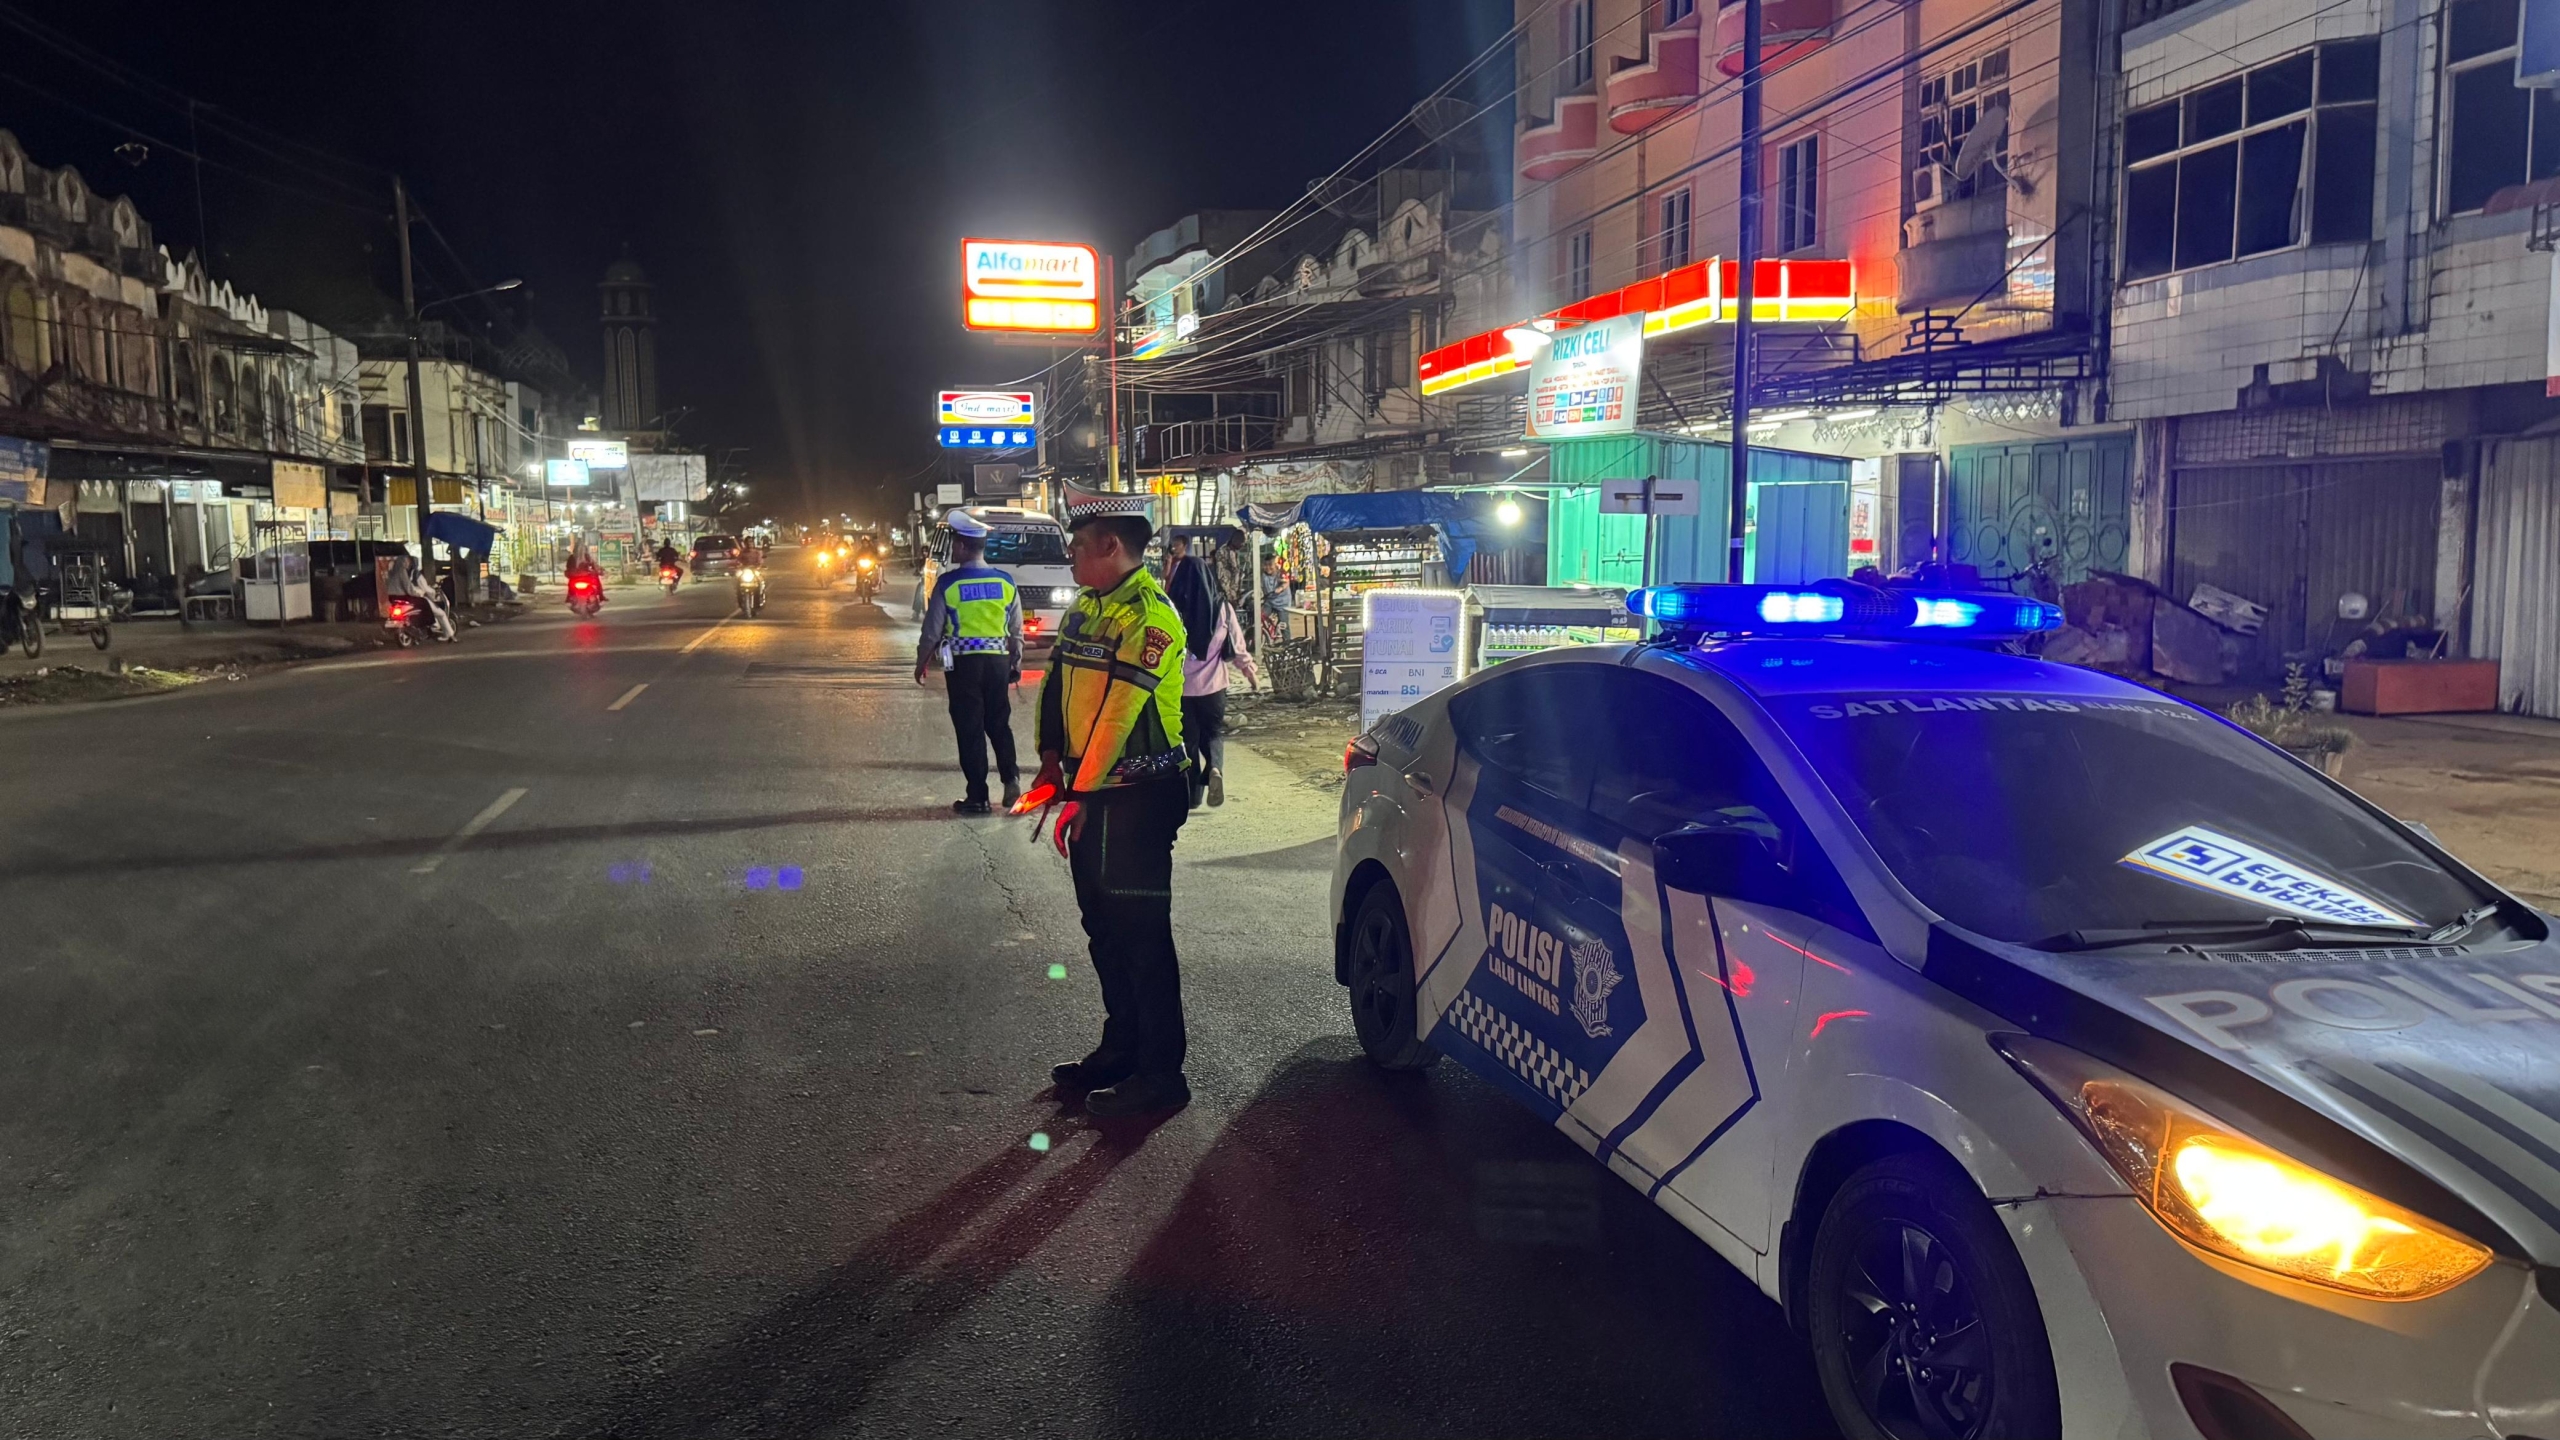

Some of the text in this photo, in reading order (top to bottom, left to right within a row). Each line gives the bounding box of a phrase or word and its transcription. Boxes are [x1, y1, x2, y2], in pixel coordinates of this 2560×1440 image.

[977, 251, 1079, 273] Alfamart
[1553, 334, 1582, 361] RIZKI
[1370, 639, 1414, 656] TUNAI
[1408, 669, 1425, 677] BNI
[1401, 684, 1420, 695] BSI
[1809, 697, 2080, 719] SATLANTAS
[1489, 902, 1564, 988] POLISI
[1489, 953, 1559, 1016] LALU LINTAS
